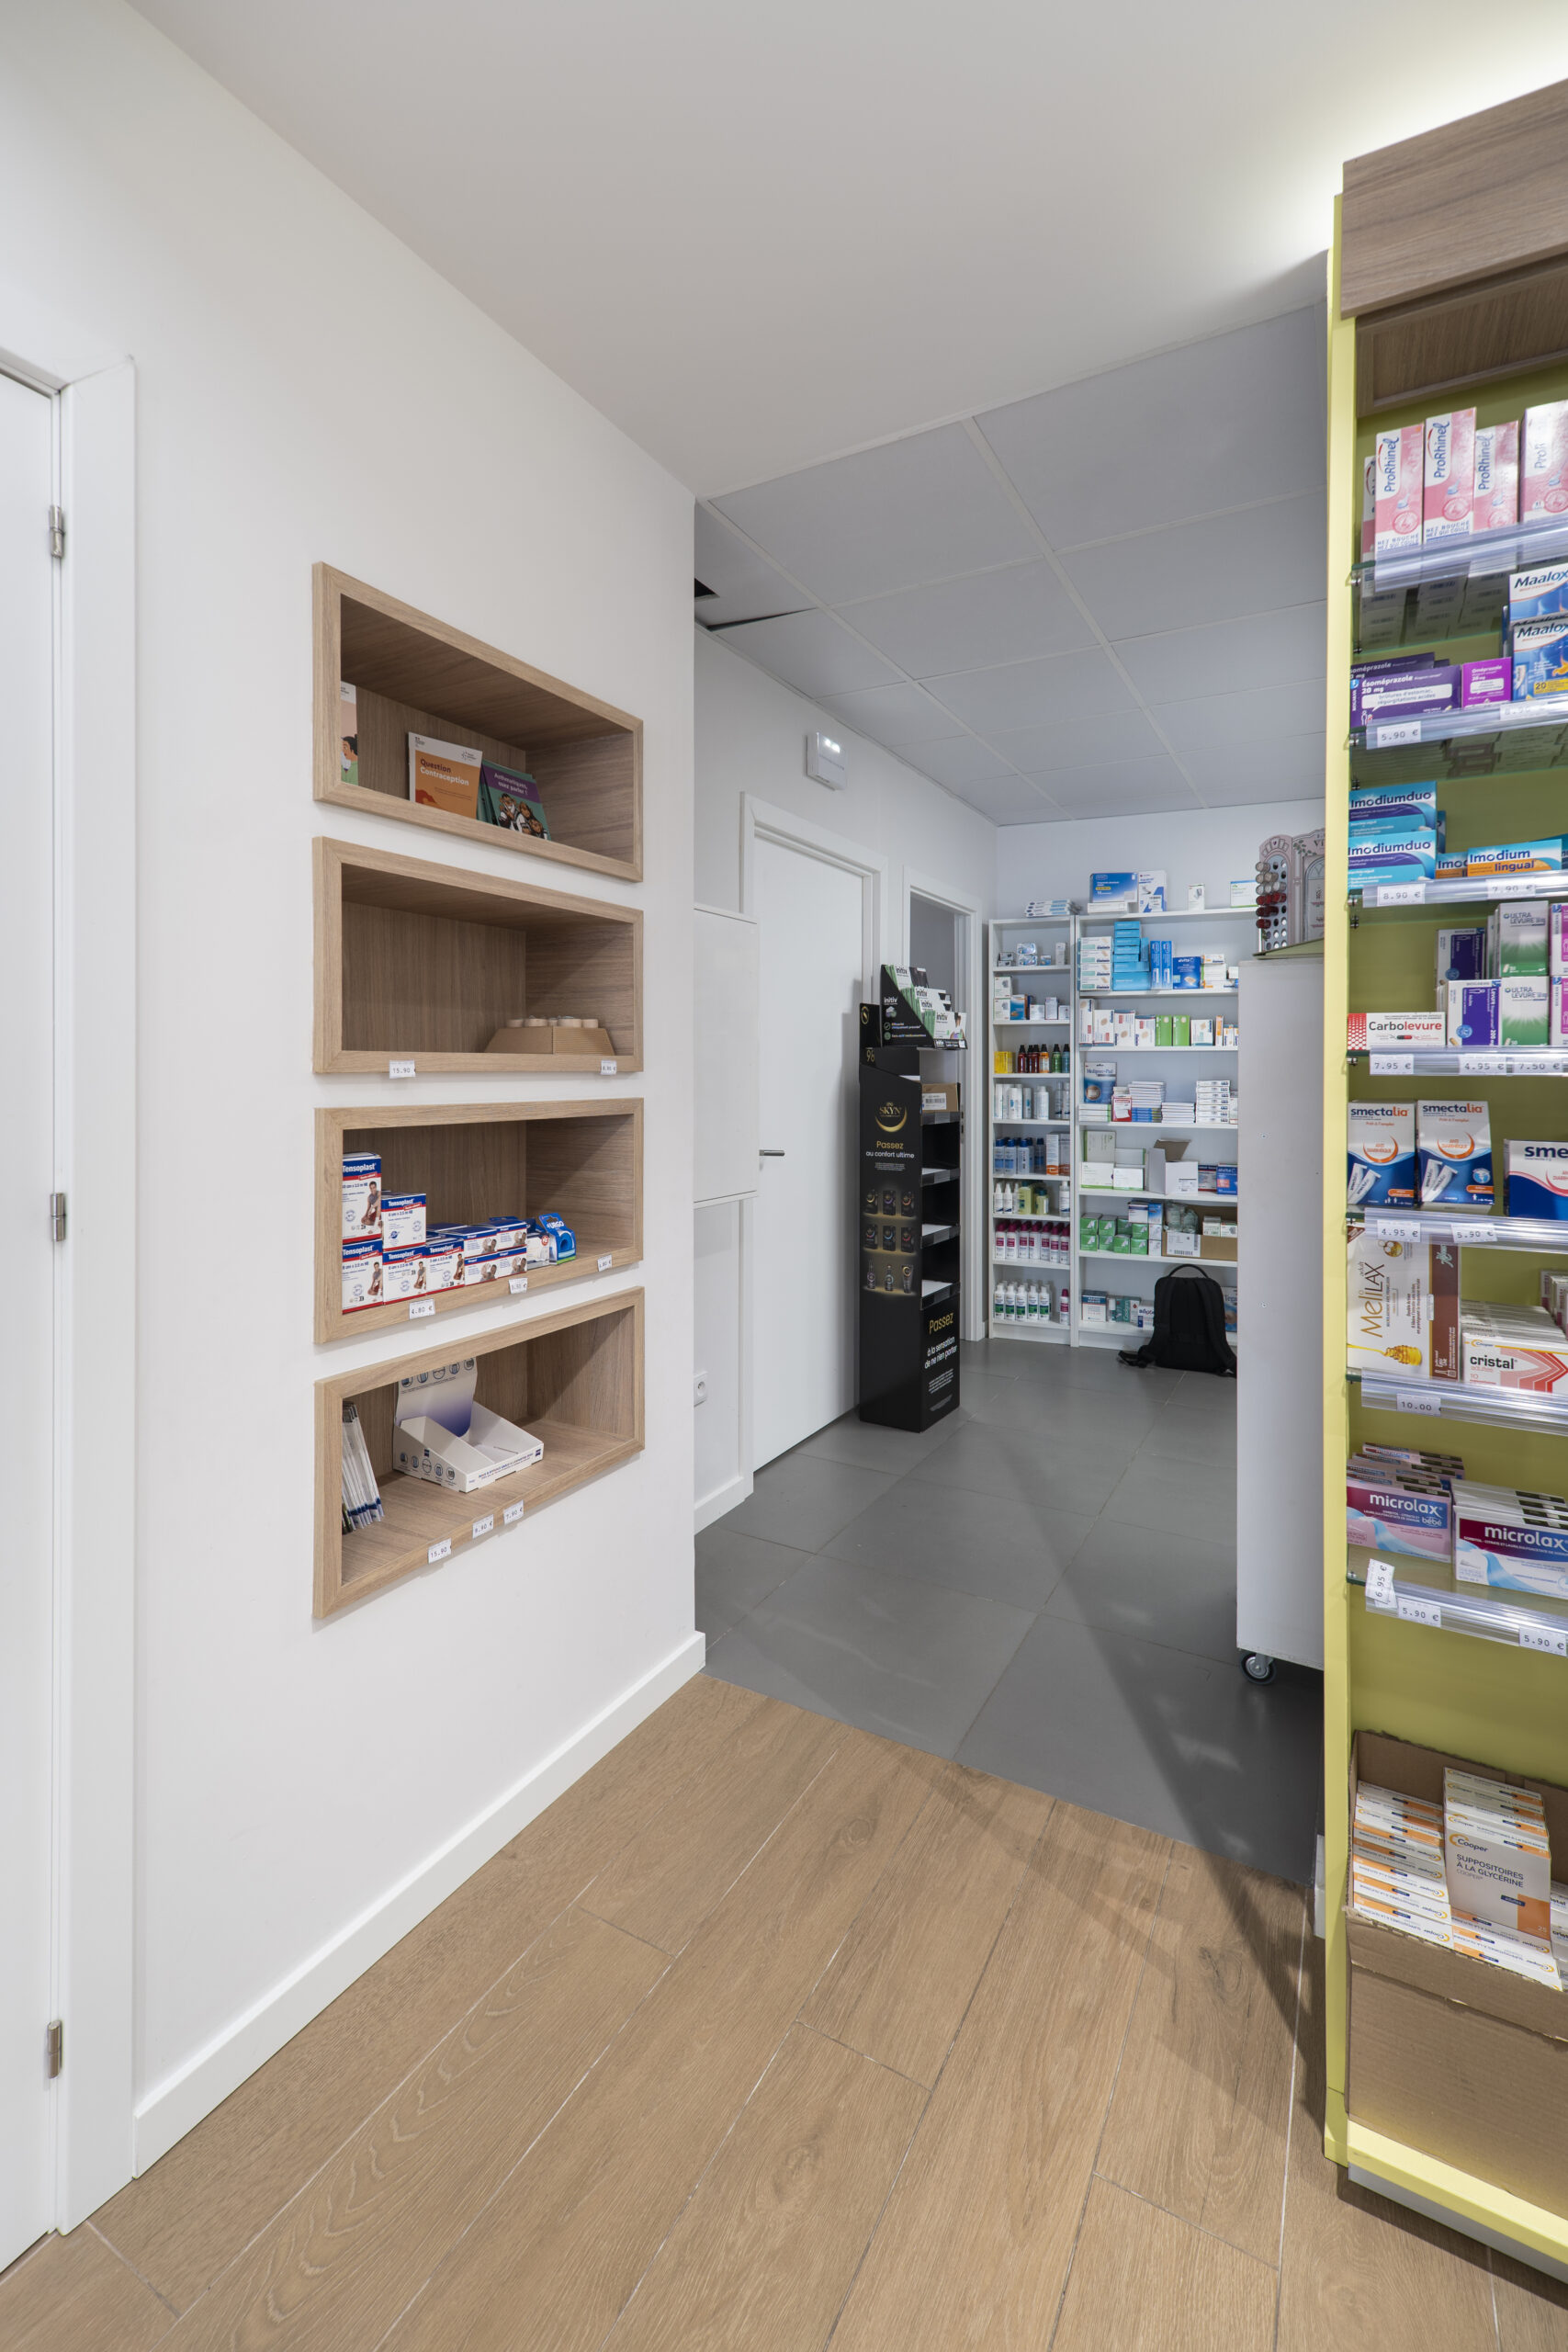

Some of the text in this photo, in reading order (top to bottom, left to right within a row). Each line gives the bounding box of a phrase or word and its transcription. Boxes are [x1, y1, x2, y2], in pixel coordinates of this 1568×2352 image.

[1433, 420, 1450, 479] ProRhinel
[1383, 436, 1399, 492] ProRhinel
[1476, 434, 1494, 491] ProRhinel
[1514, 570, 1568, 588] Maalox
[1517, 621, 1568, 639] Maalox
[1350, 662, 1391, 673] soméprazole
[1362, 674, 1414, 689] Ésoméprazole
[1535, 682, 1547, 691] 20
[1361, 686, 1383, 695] 20 mg
[1381, 731, 1405, 741] 5.90
[421, 759, 451, 774] Question
[420, 766, 469, 786] Contraception
[510, 784, 525, 795] parler
[1350, 791, 1432, 808] Imodiumduo
[1348, 840, 1431, 856] Imodiumduo
[1470, 849, 1530, 864] Imodium
[1494, 860, 1534, 873] lingual
[1383, 892, 1407, 900] 8.90
[1511, 986, 1533, 994] ULTRA
[1369, 1021, 1442, 1031] Carbolevure
[1374, 1062, 1398, 1070] 7.95
[1464, 1062, 1490, 1070] 4.95
[1519, 1062, 1545, 1070] 7.50
[879, 1106, 901, 1115] SKYN
[1350, 1105, 1409, 1117] smectalia
[1423, 1102, 1483, 1114] smectalia
[876, 1140, 904, 1149] Passez
[342, 1162, 376, 1173] Tensoplast
[388, 1198, 413, 1207] Tensoplast
[551, 1220, 565, 1229] URGO
[1382, 1228, 1405, 1237] 4.95
[1457, 1230, 1481, 1238] 5.90
[343, 1245, 373, 1256] Tensoplast
[389, 1250, 414, 1260] Tensoplast
[429, 1244, 454, 1254] Tensoplast
[929, 1312, 953, 1335] Passez
[924, 1360, 931, 1369] de
[944, 1345, 958, 1361] porter
[1470, 1355, 1515, 1370] cristal
[1401, 1401, 1432, 1411] 10.00
[1370, 1494, 1442, 1520] microlax
[505, 1510, 517, 1520] 7.90
[1421, 1517, 1442, 1527] bébé
[1484, 1526, 1568, 1555] microlax
[430, 1546, 447, 1558] 15.90
[1375, 1576, 1385, 1598] 6.95
[1402, 1607, 1426, 1619] 5.90
[1524, 1634, 1564, 1650] 5.90 €
[1457, 1838, 1489, 1852] Cooper
[1456, 1853, 1524, 1881] SUPPOSITOIRES
[1456, 1860, 1523, 1888] À LA GLYCÉRINE
